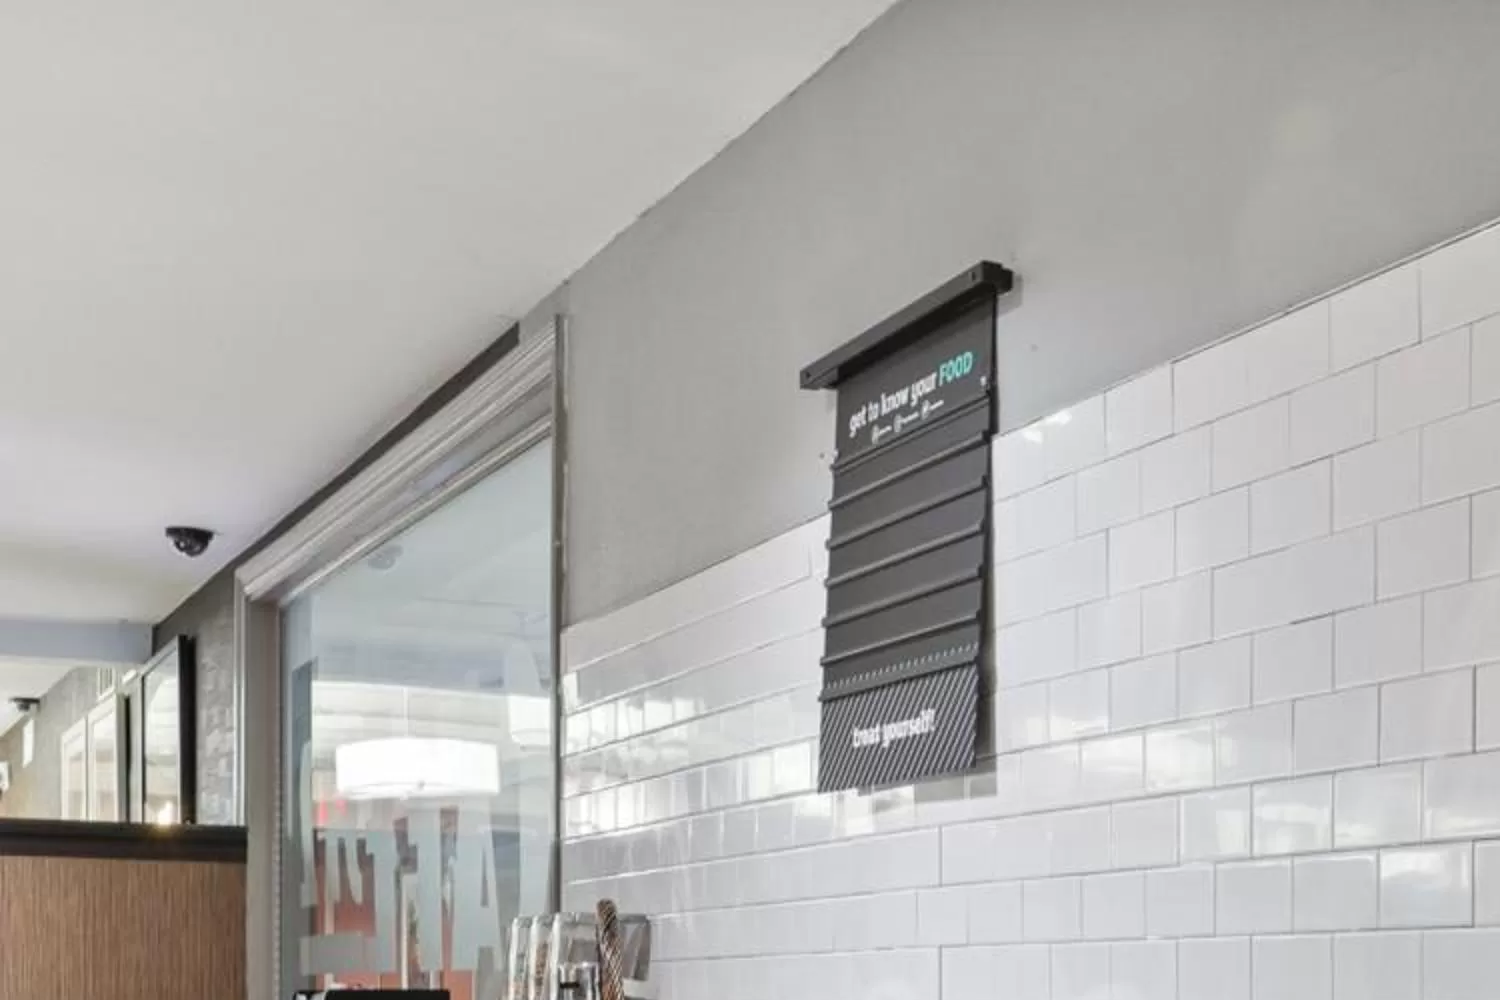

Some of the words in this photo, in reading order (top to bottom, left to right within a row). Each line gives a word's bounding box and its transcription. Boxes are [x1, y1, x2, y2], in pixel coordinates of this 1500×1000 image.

[849, 405, 867, 438] get
[868, 401, 879, 422] to
[881, 387, 909, 416] know
[910, 372, 937, 407] your
[939, 351, 973, 387] FOOD
[853, 724, 880, 748] treat
